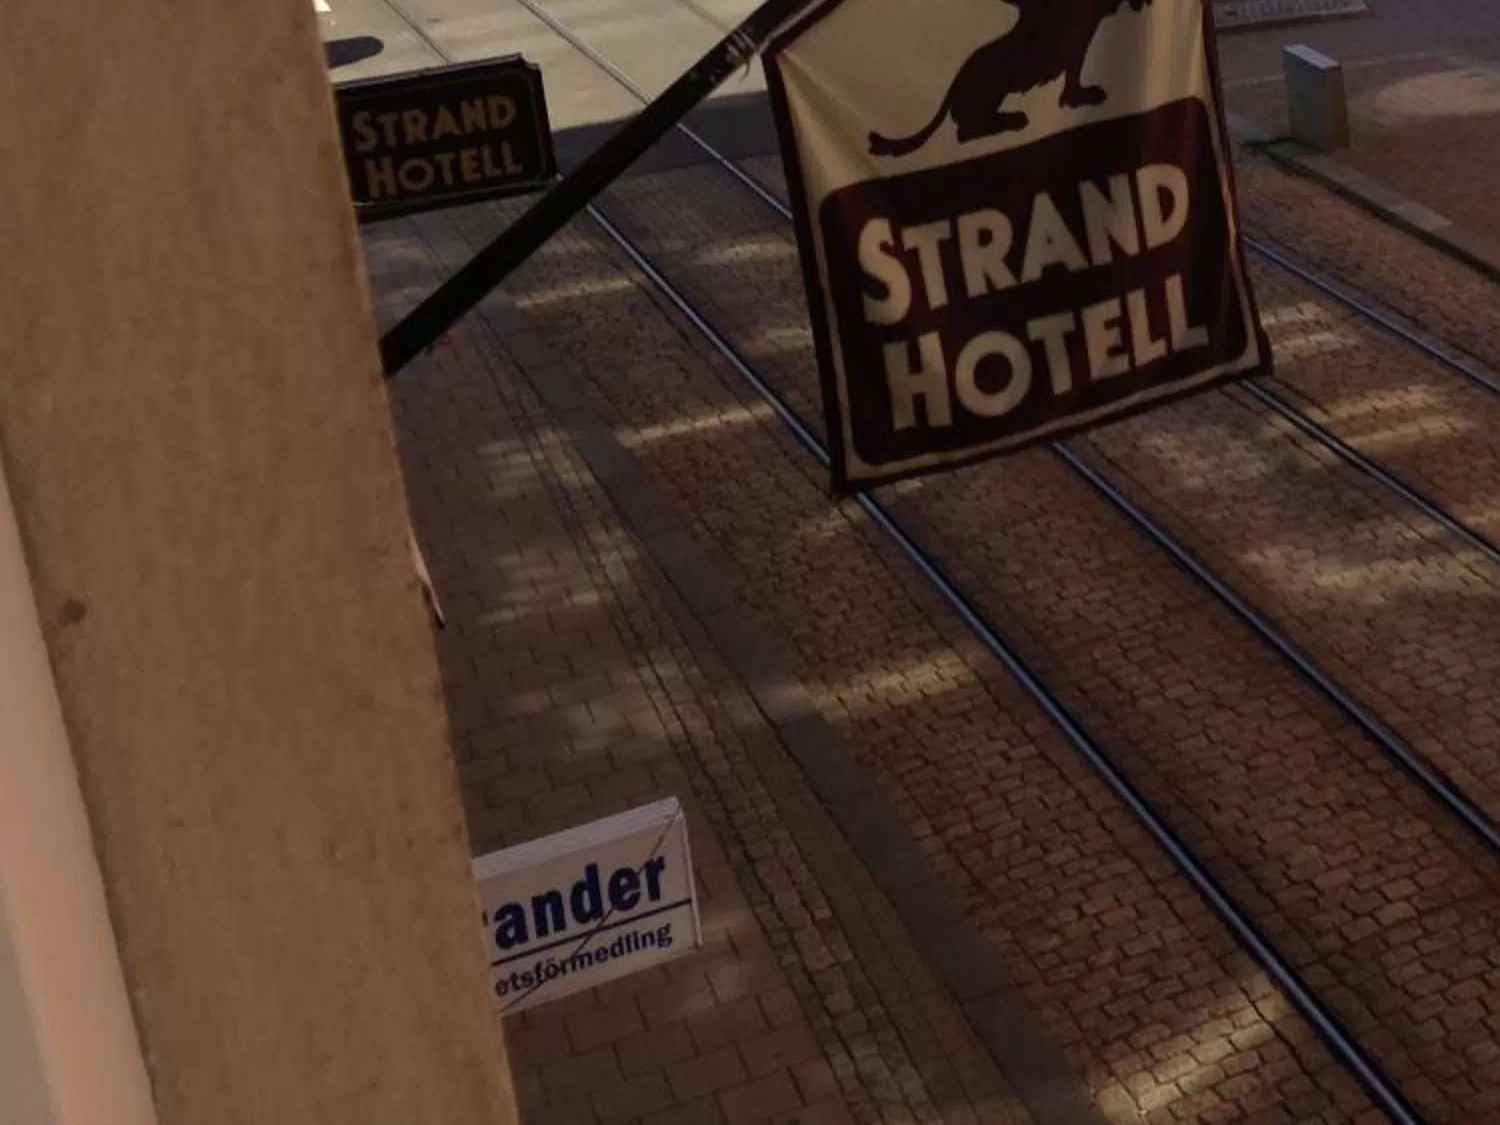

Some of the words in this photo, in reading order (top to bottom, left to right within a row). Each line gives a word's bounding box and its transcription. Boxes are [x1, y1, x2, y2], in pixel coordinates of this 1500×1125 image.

[353, 94, 516, 154] STRAND
[364, 143, 523, 199] HOTELL
[856, 162, 1191, 326] STRAND
[882, 273, 1210, 433] HOTELL
[482, 855, 666, 950] ander
